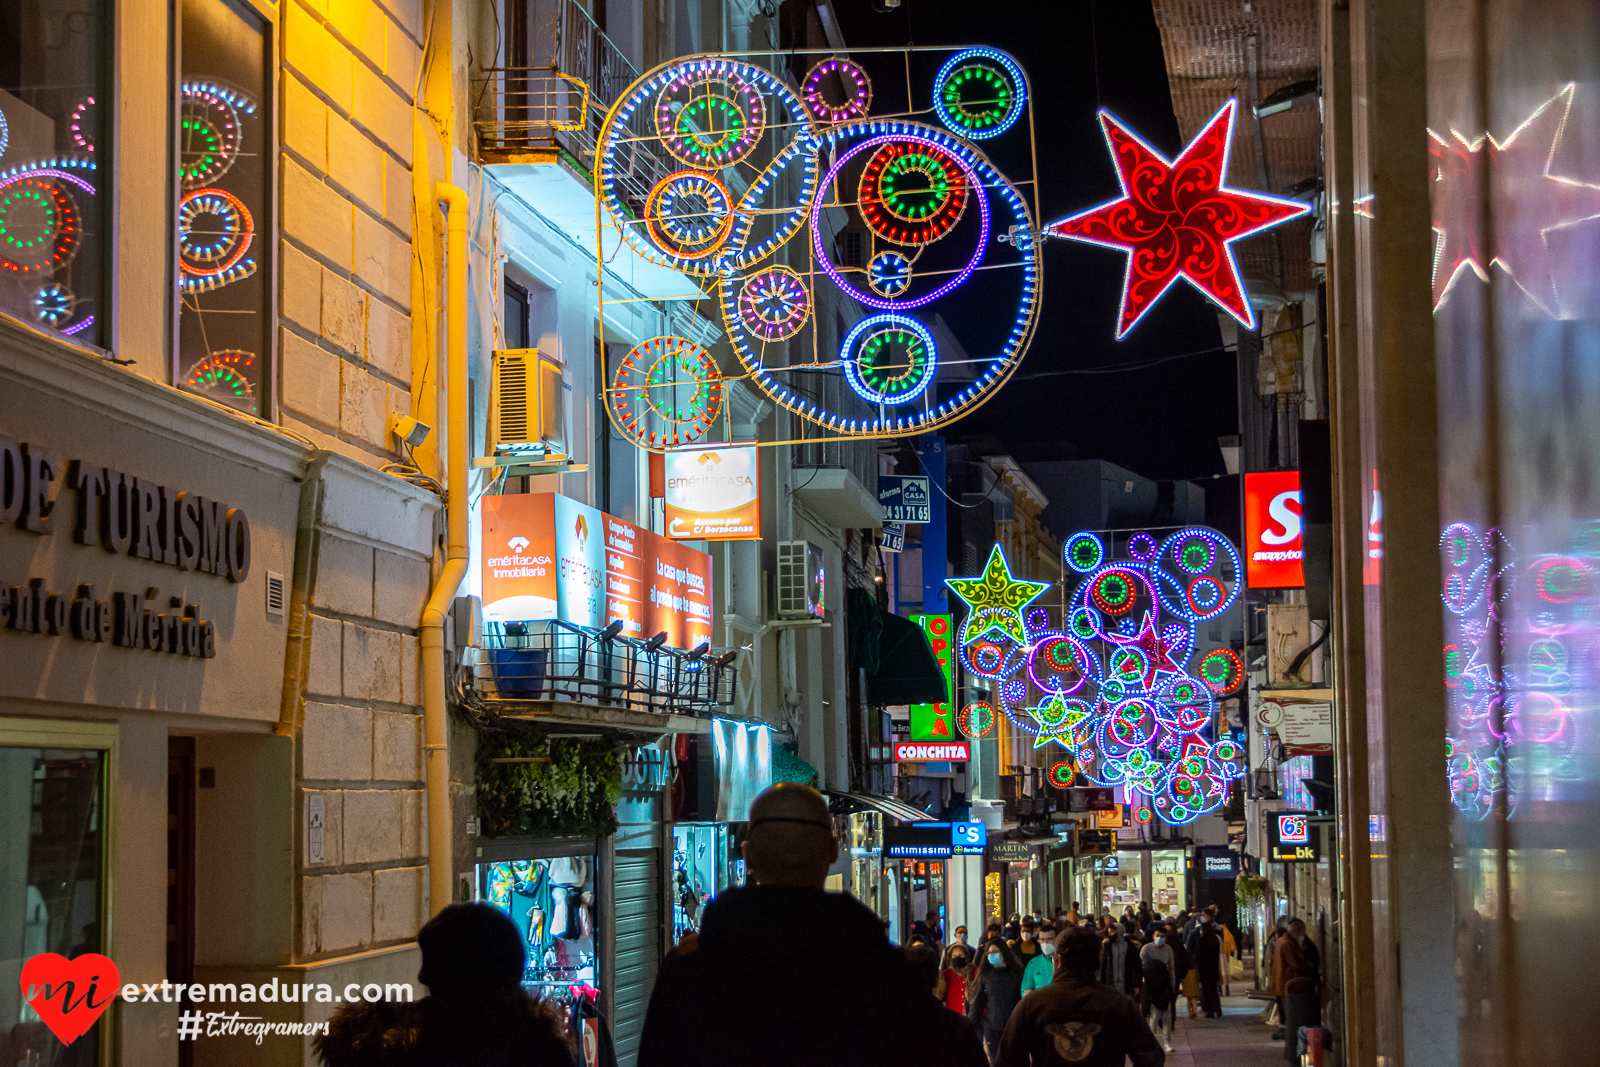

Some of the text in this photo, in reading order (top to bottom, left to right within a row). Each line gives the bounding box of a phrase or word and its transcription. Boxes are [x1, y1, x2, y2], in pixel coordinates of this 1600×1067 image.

[880, 487, 901, 499] nforma
[0, 437, 251, 584] DE TURISMO
[894, 505, 904, 519] 31
[906, 506, 916, 520] 71
[918, 506, 928, 520] 65
[1260, 490, 1303, 545] S
[704, 525, 753, 534] Berzocanas
[725, 518, 741, 527] por
[882, 533, 902, 550] 71 65
[493, 567, 546, 578] inmobiliaria
[656, 558, 664, 576] La
[664, 563, 676, 581] casa
[676, 568, 686, 587] que
[673, 595, 683, 614] que
[0, 577, 217, 659] ento de Mérida
[897, 745, 967, 759] CONCHITA
[966, 826, 980, 843] S
[889, 845, 951, 855] intimissimi
[1205, 863, 1232, 871] House
